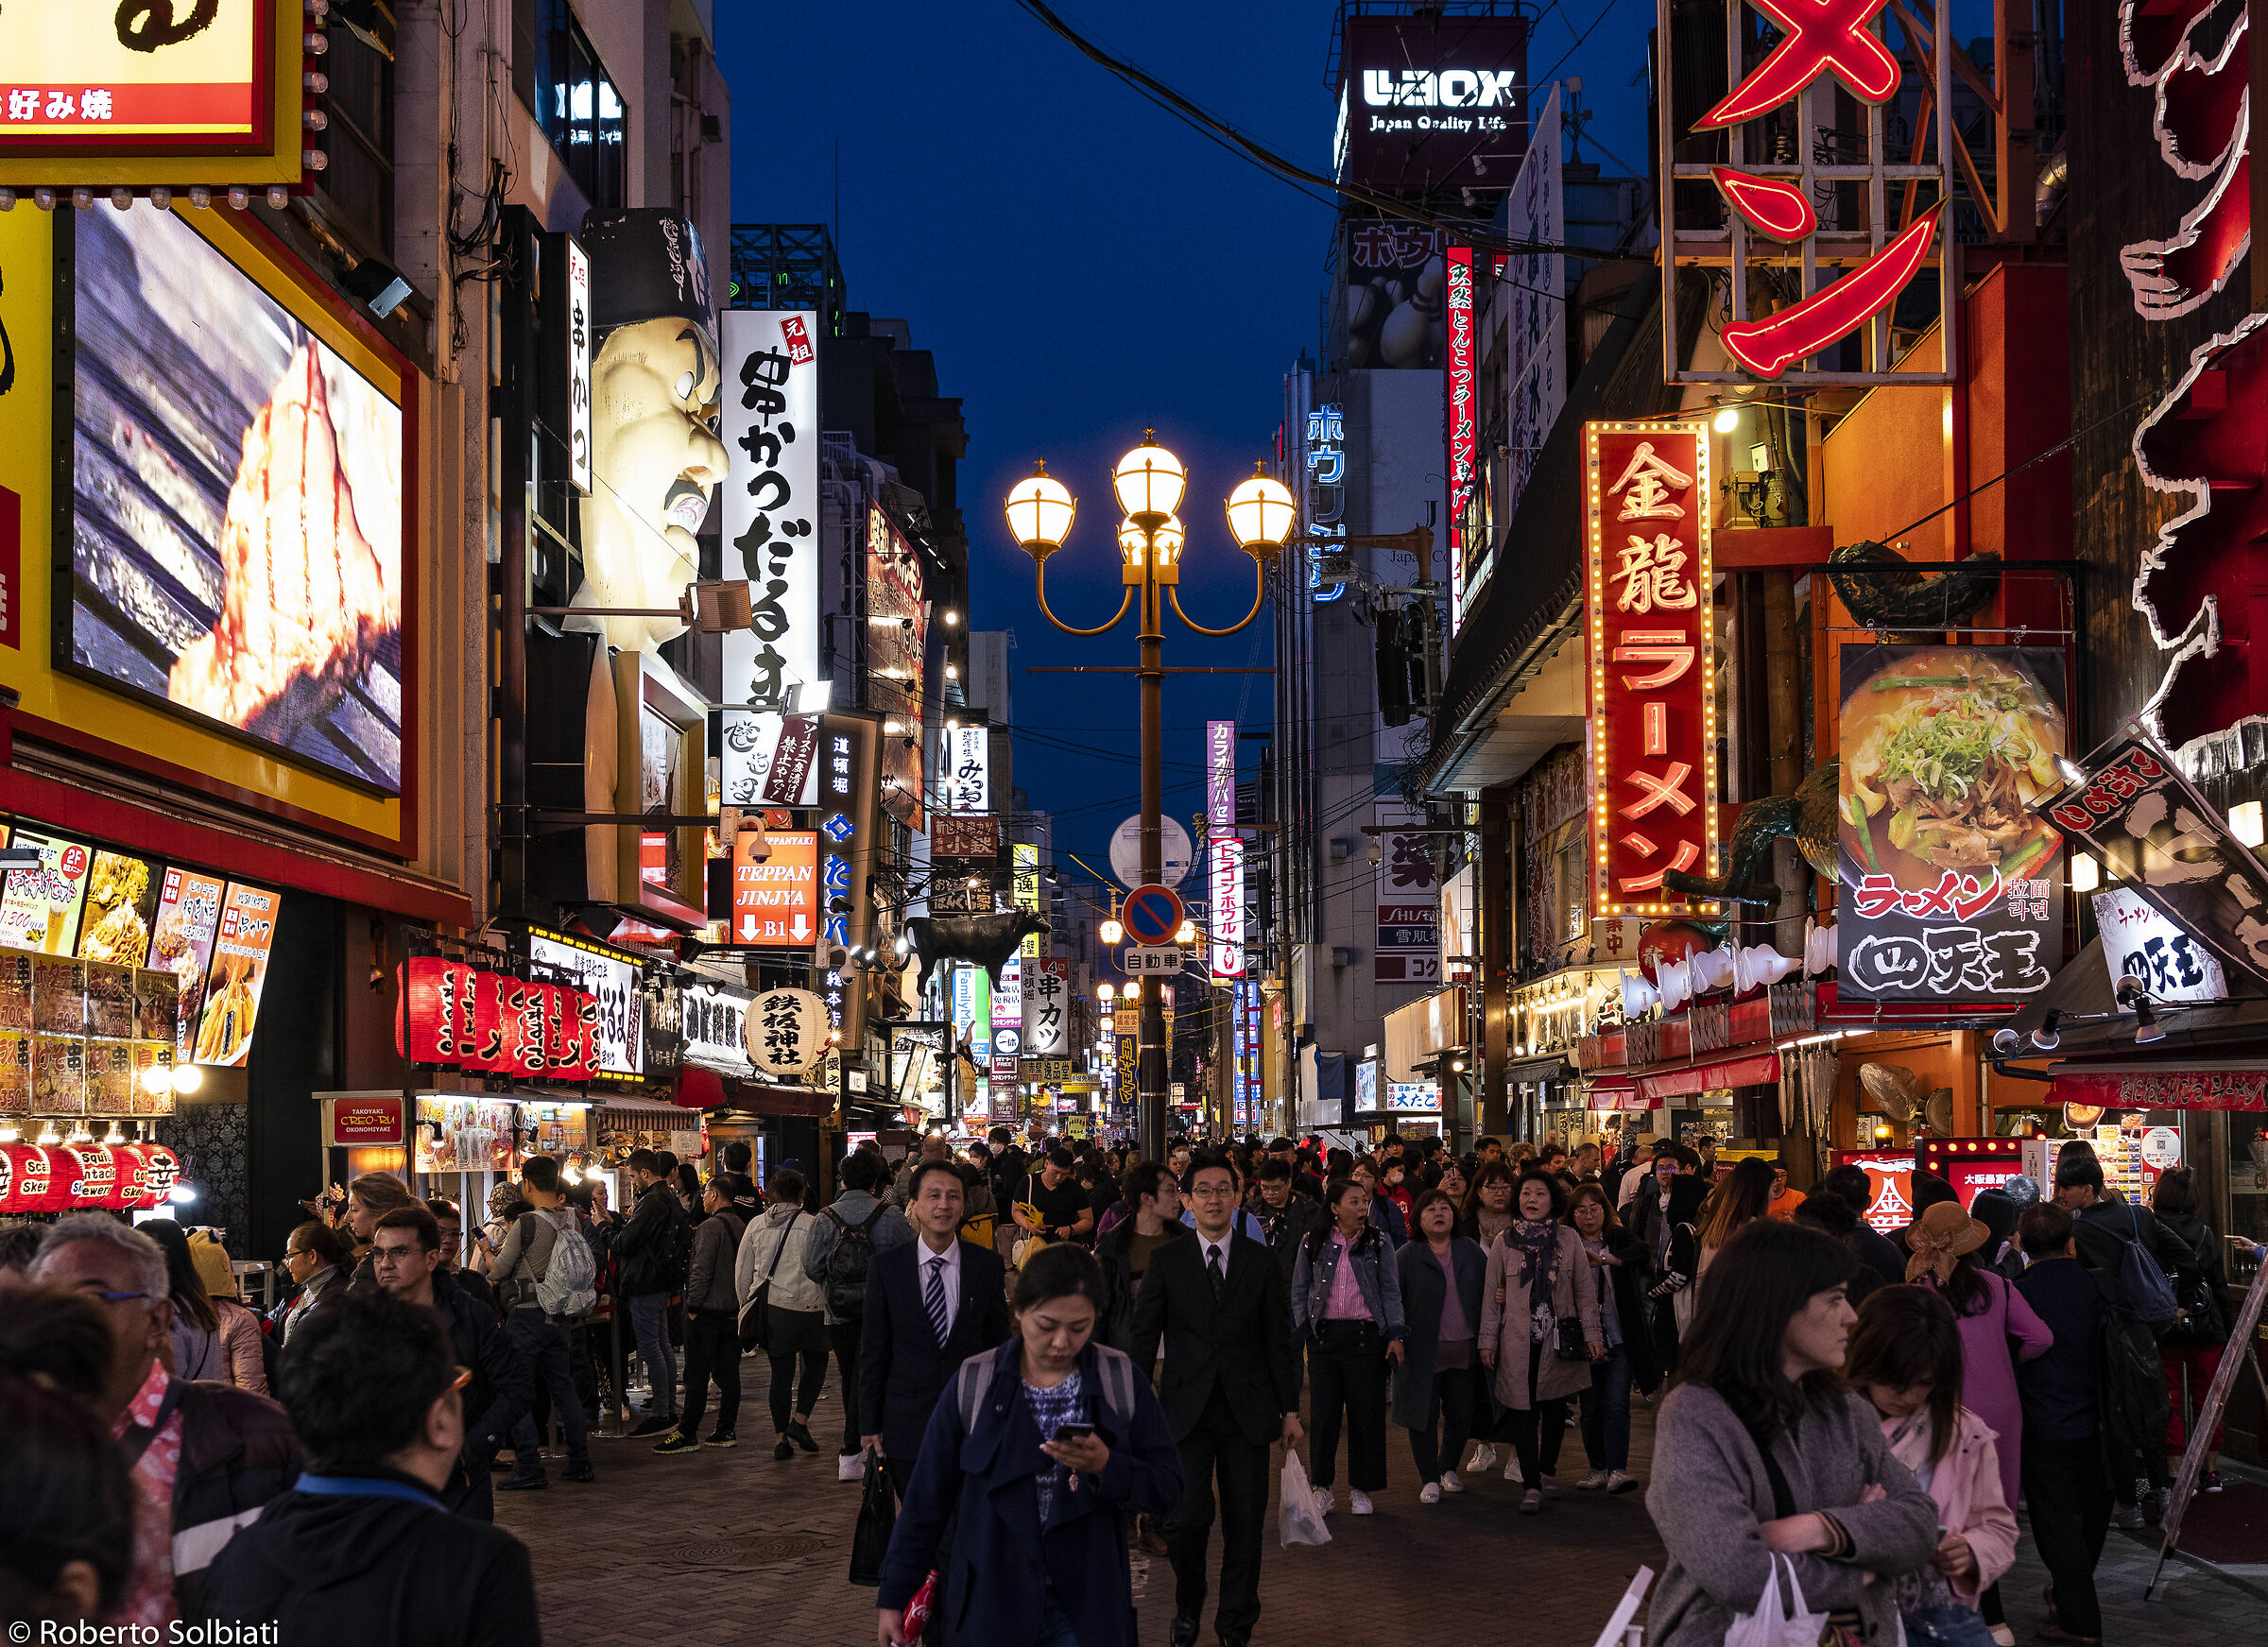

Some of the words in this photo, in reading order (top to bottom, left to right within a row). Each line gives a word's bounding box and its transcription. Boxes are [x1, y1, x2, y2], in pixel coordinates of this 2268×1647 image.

[0, 89, 112, 121] 好み焼
[1370, 115, 1412, 132] Japan
[1418, 115, 1472, 132] Quality
[786, 318, 812, 364] 元祖
[573, 300, 587, 469] 串かつ
[1449, 264, 1474, 522] 天然とんこつラーメン専門
[733, 346, 811, 714] 串かつだるま
[1607, 441, 1699, 894] 金龍ラーメン
[833, 737, 850, 795] 道頓堀
[760, 835, 814, 847] EPPANYAKI
[936, 819, 964, 834] 新世界
[67, 849, 82, 866] 2F
[737, 865, 814, 884] TEPPAN
[1220, 844, 1236, 935] ドラゴンボウル
[2007, 879, 2051, 900] 拉面
[736, 890, 807, 908] JINJYA
[1854, 866, 2002, 923] ラーメン
[2008, 900, 2050, 921] 라면
[765, 920, 786, 938] B1
[2118, 905, 2152, 926] ラーメン
[0, 954, 30, 990] テ串
[35, 960, 85, 993] ホタテ串
[1127, 953, 1178, 969] 自動車
[1847, 928, 2051, 994] 四天王
[2122, 935, 2204, 993] 四天王
[1022, 964, 1035, 1000] 道頓堀
[1038, 974, 1062, 1050] 串カツ
[762, 993, 803, 1066] 鉄板神社
[35, 1042, 83, 1074] げそ串
[1396, 1093, 1435, 1107] 大たこ
[341, 1115, 395, 1126] CREO-RU
[346, 1125, 391, 1134] OKONOMIYAKI
[84, 1168, 115, 1179] ntacle
